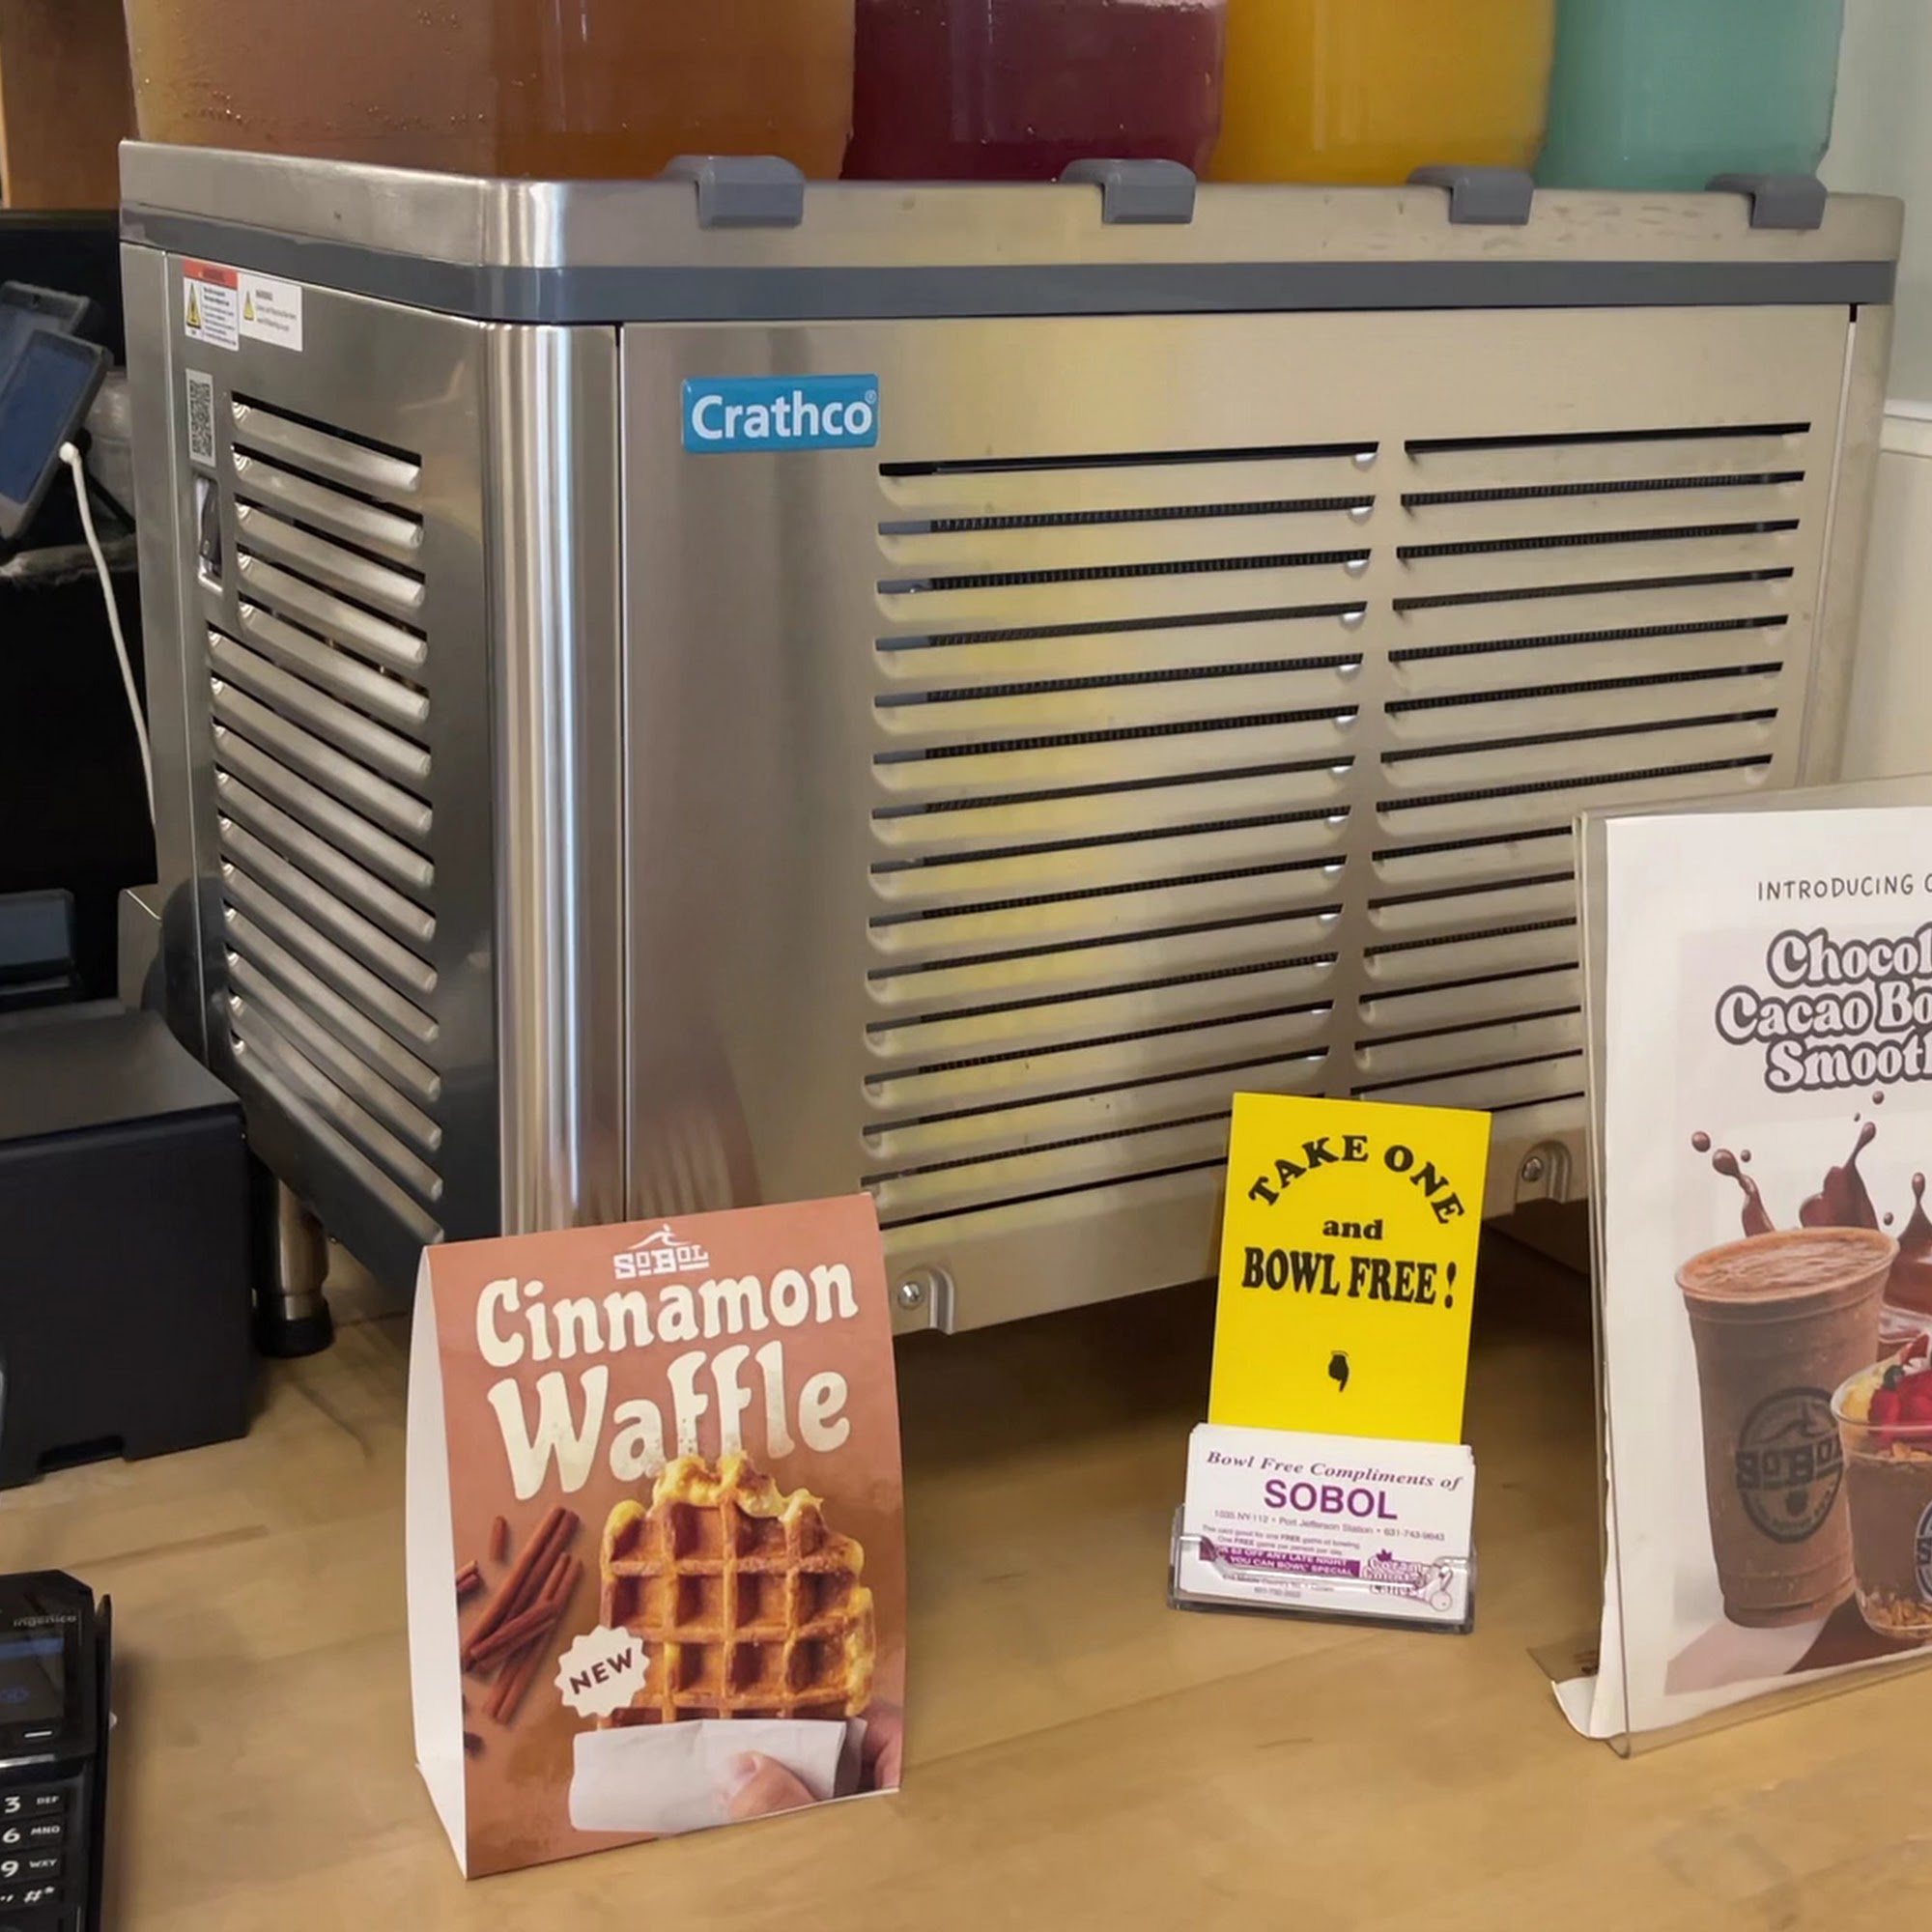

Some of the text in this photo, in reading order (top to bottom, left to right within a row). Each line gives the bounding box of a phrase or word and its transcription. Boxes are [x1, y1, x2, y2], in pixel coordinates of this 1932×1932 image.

[1757, 873, 1914, 900] INTRODUCING
[1716, 985, 1875, 1045] Cacao
[1765, 1027, 1932, 1094] Smoot
[1248, 1134, 1465, 1224] TAKE ONE
[1322, 1219, 1383, 1240] and
[1241, 1246, 1341, 1296] BOWL
[476, 1263, 859, 1368] Cinnamon
[487, 1340, 851, 1501] Waffle
[1207, 1451, 1463, 1492] Bowl Free Compliments of
[1264, 1479, 1398, 1520] SOBOL
[569, 1647, 633, 1695] NEW
[4, 1796, 59, 1814] 3 DEF
[2, 1825, 61, 1844] 6 MNO
[0, 1861, 19, 1878] 9
